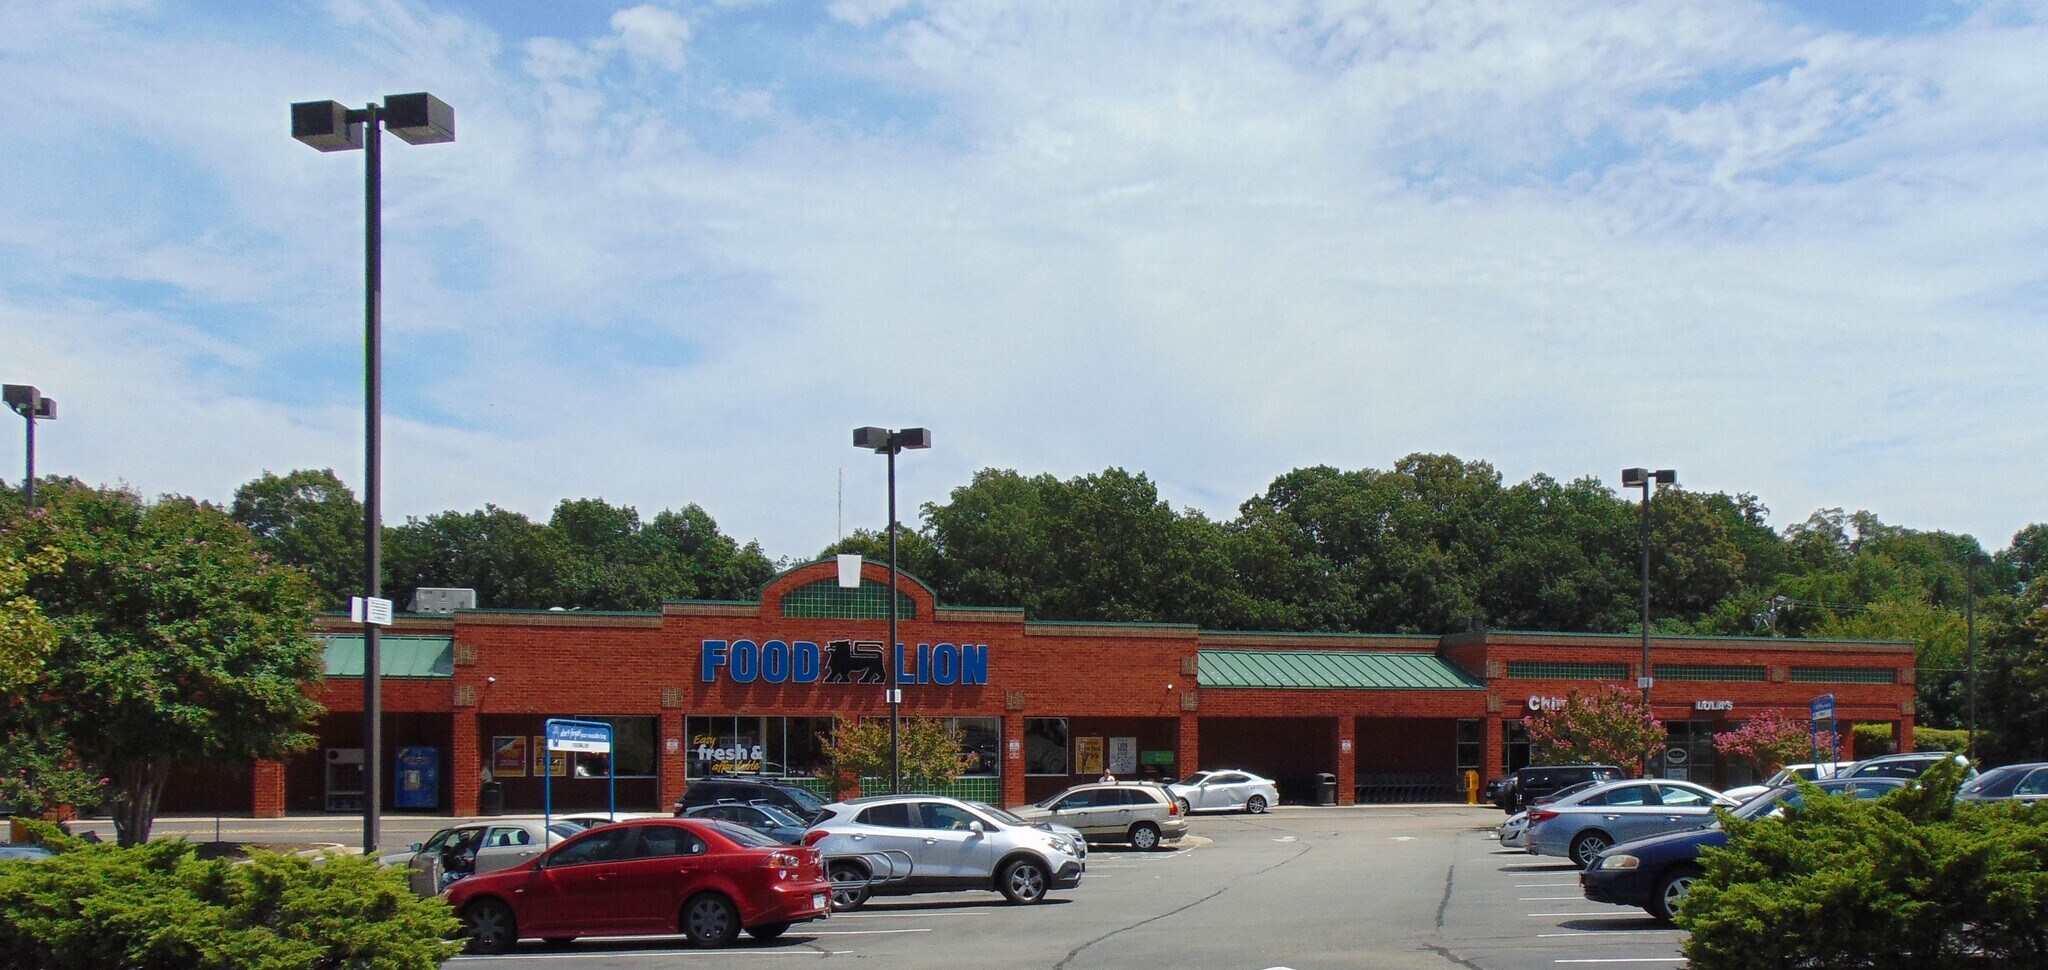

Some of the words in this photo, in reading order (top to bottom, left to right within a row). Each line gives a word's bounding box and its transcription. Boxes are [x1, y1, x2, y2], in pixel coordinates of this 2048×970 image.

[701, 639, 820, 684] FOOD
[894, 643, 988, 685] LION
[693, 734, 717, 749] Easy
[697, 744, 748, 761] fresh
[750, 745, 763, 760] &
[711, 760, 760, 773] affordable
